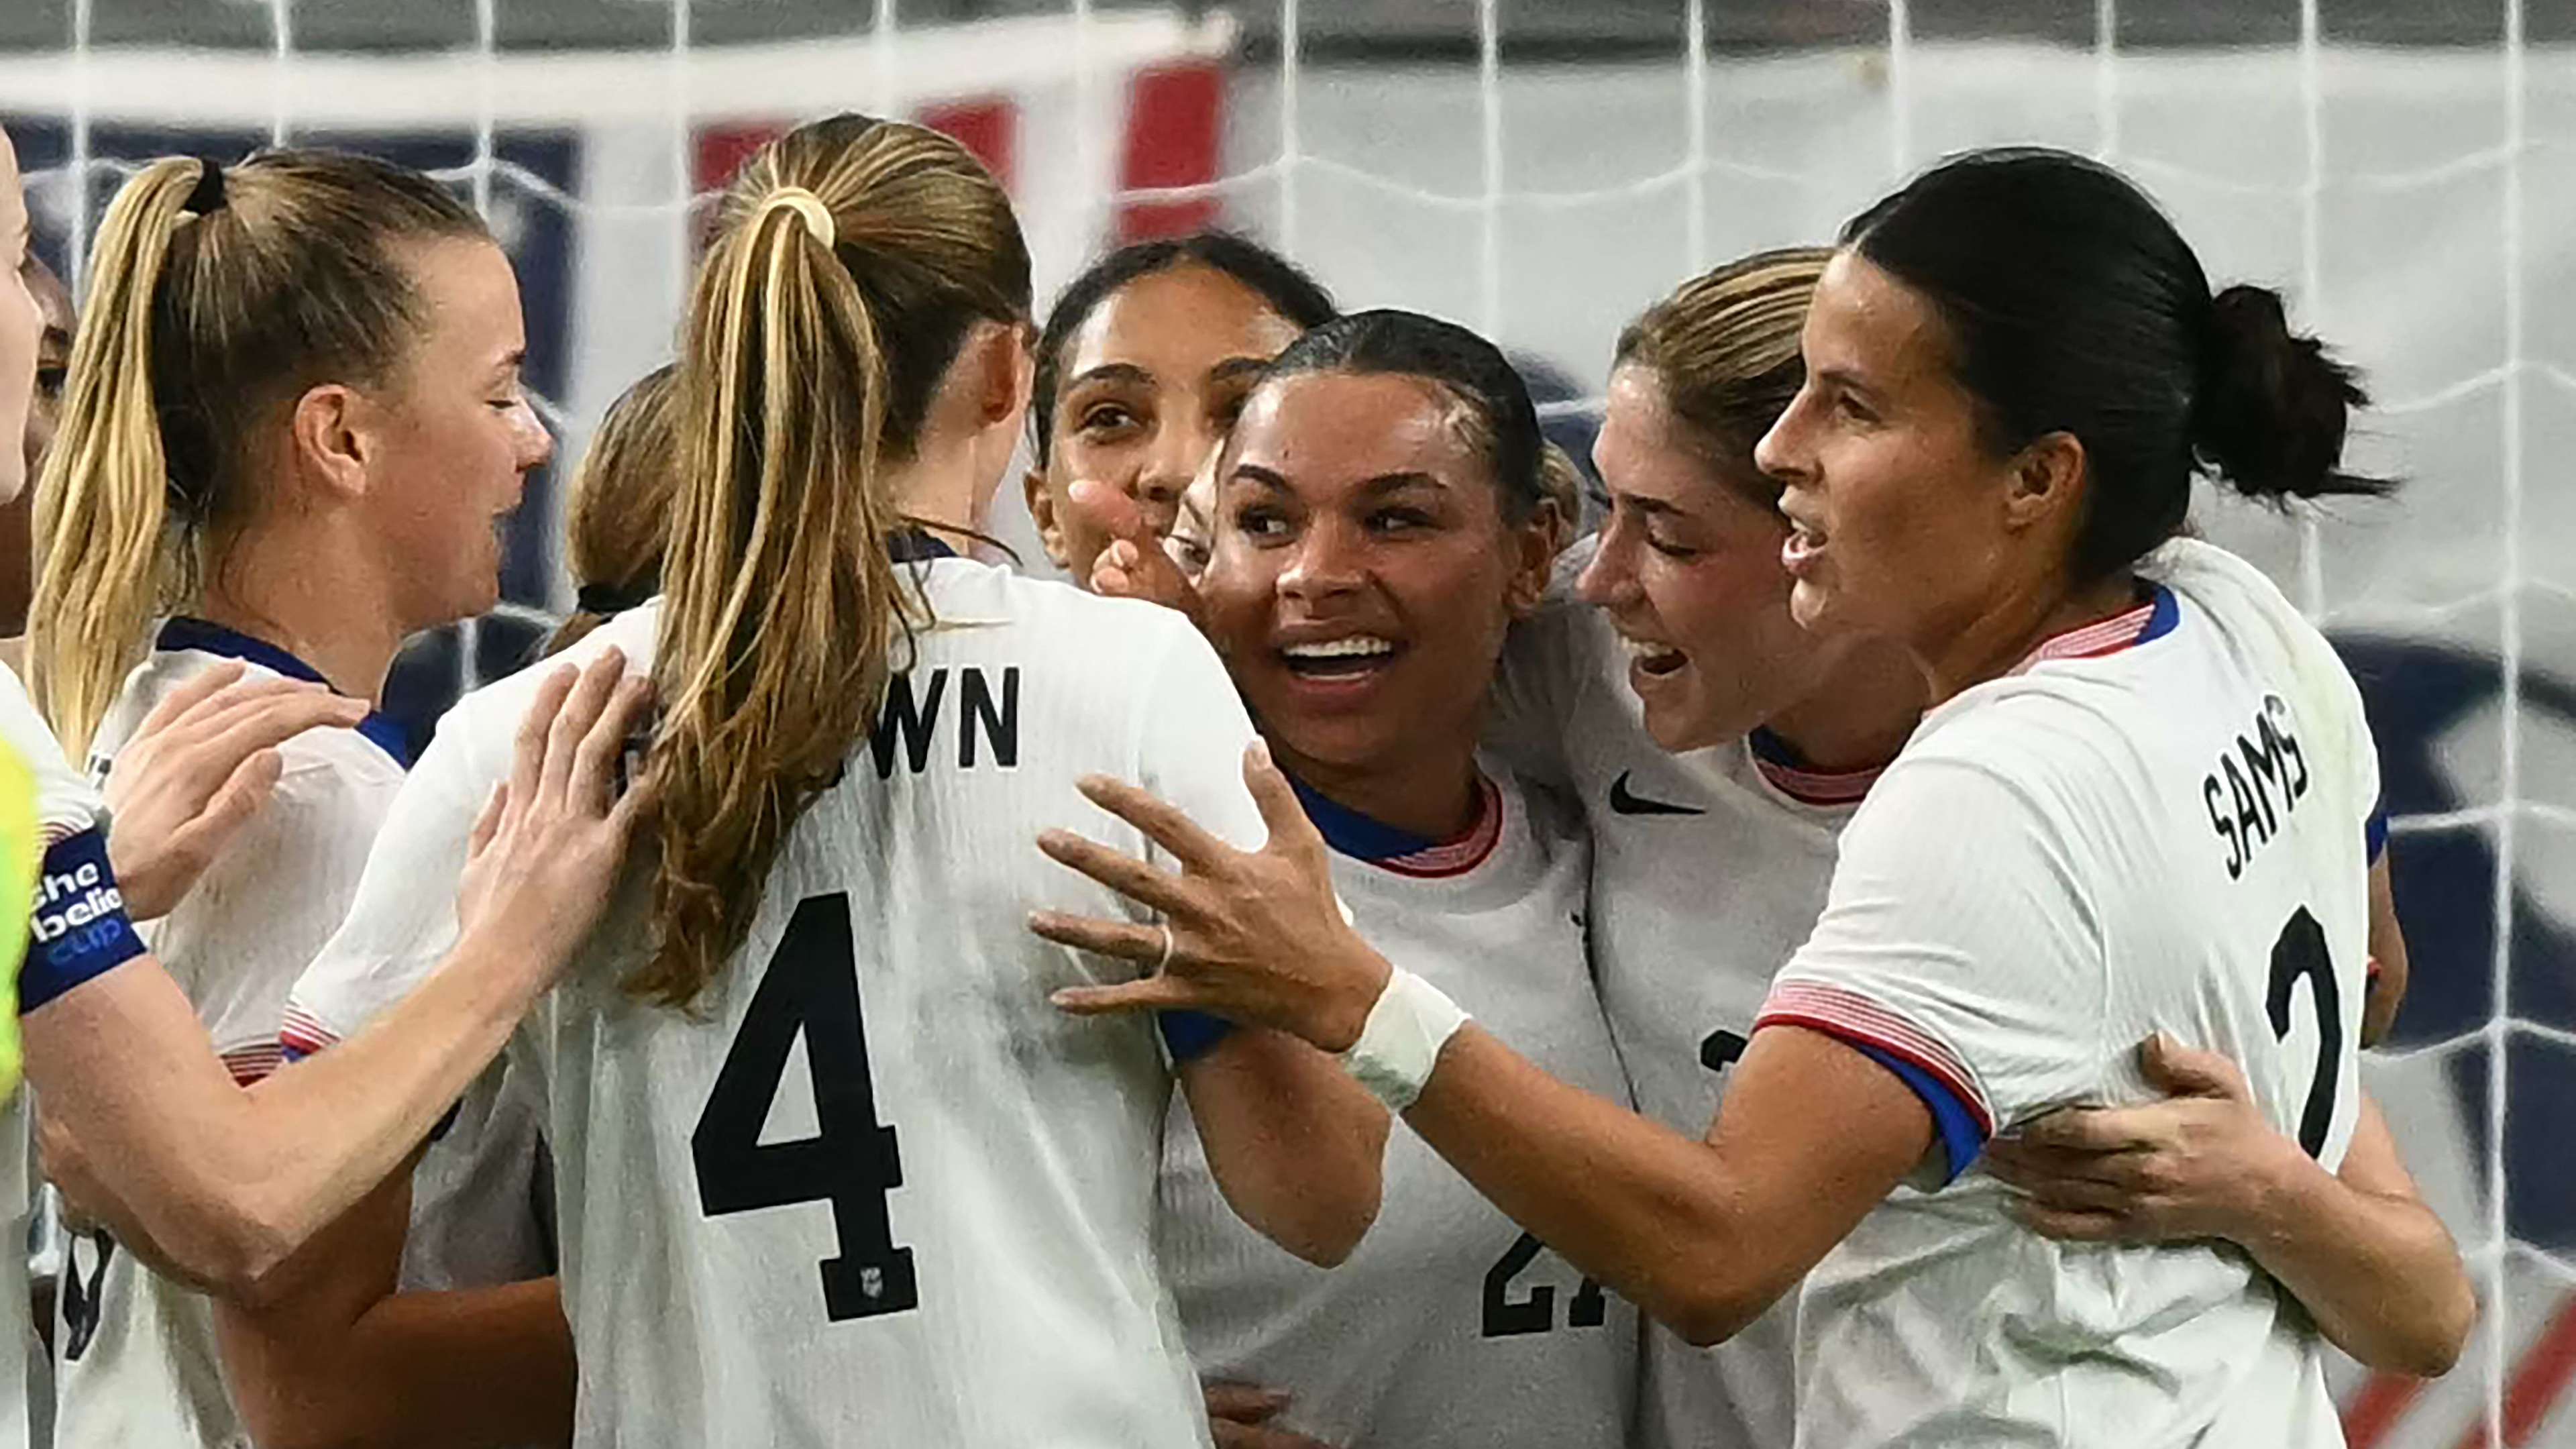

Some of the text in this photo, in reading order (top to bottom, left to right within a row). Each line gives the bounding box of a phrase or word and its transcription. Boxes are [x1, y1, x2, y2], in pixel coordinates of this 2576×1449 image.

[2204, 694, 2308, 880] SAMS
[48, 918, 121, 965] cup
[692, 891, 918, 1322] 4
